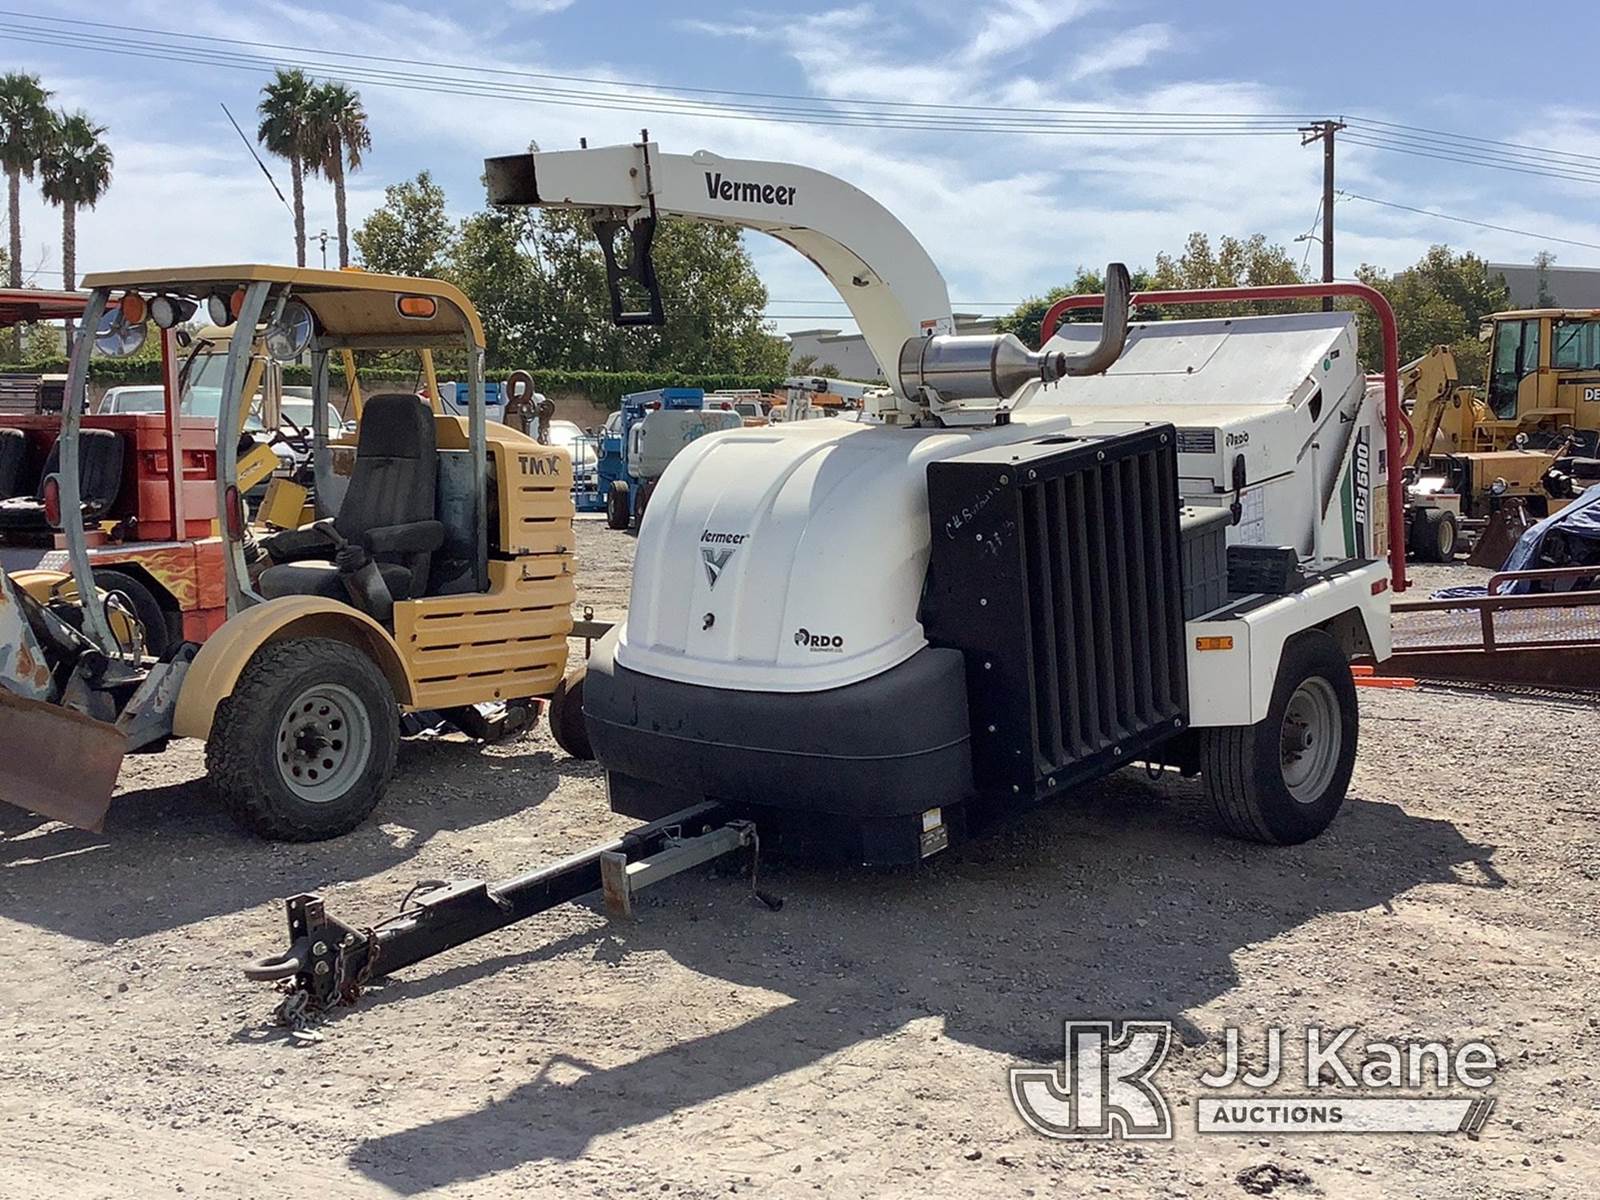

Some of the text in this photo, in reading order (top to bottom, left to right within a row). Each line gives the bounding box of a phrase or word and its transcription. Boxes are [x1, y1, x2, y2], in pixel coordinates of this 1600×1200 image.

[705, 172, 796, 205] Vermeer
[1234, 431, 1250, 444] RDO
[1355, 442, 1370, 525] BC1500
[810, 635, 844, 647] RDO
